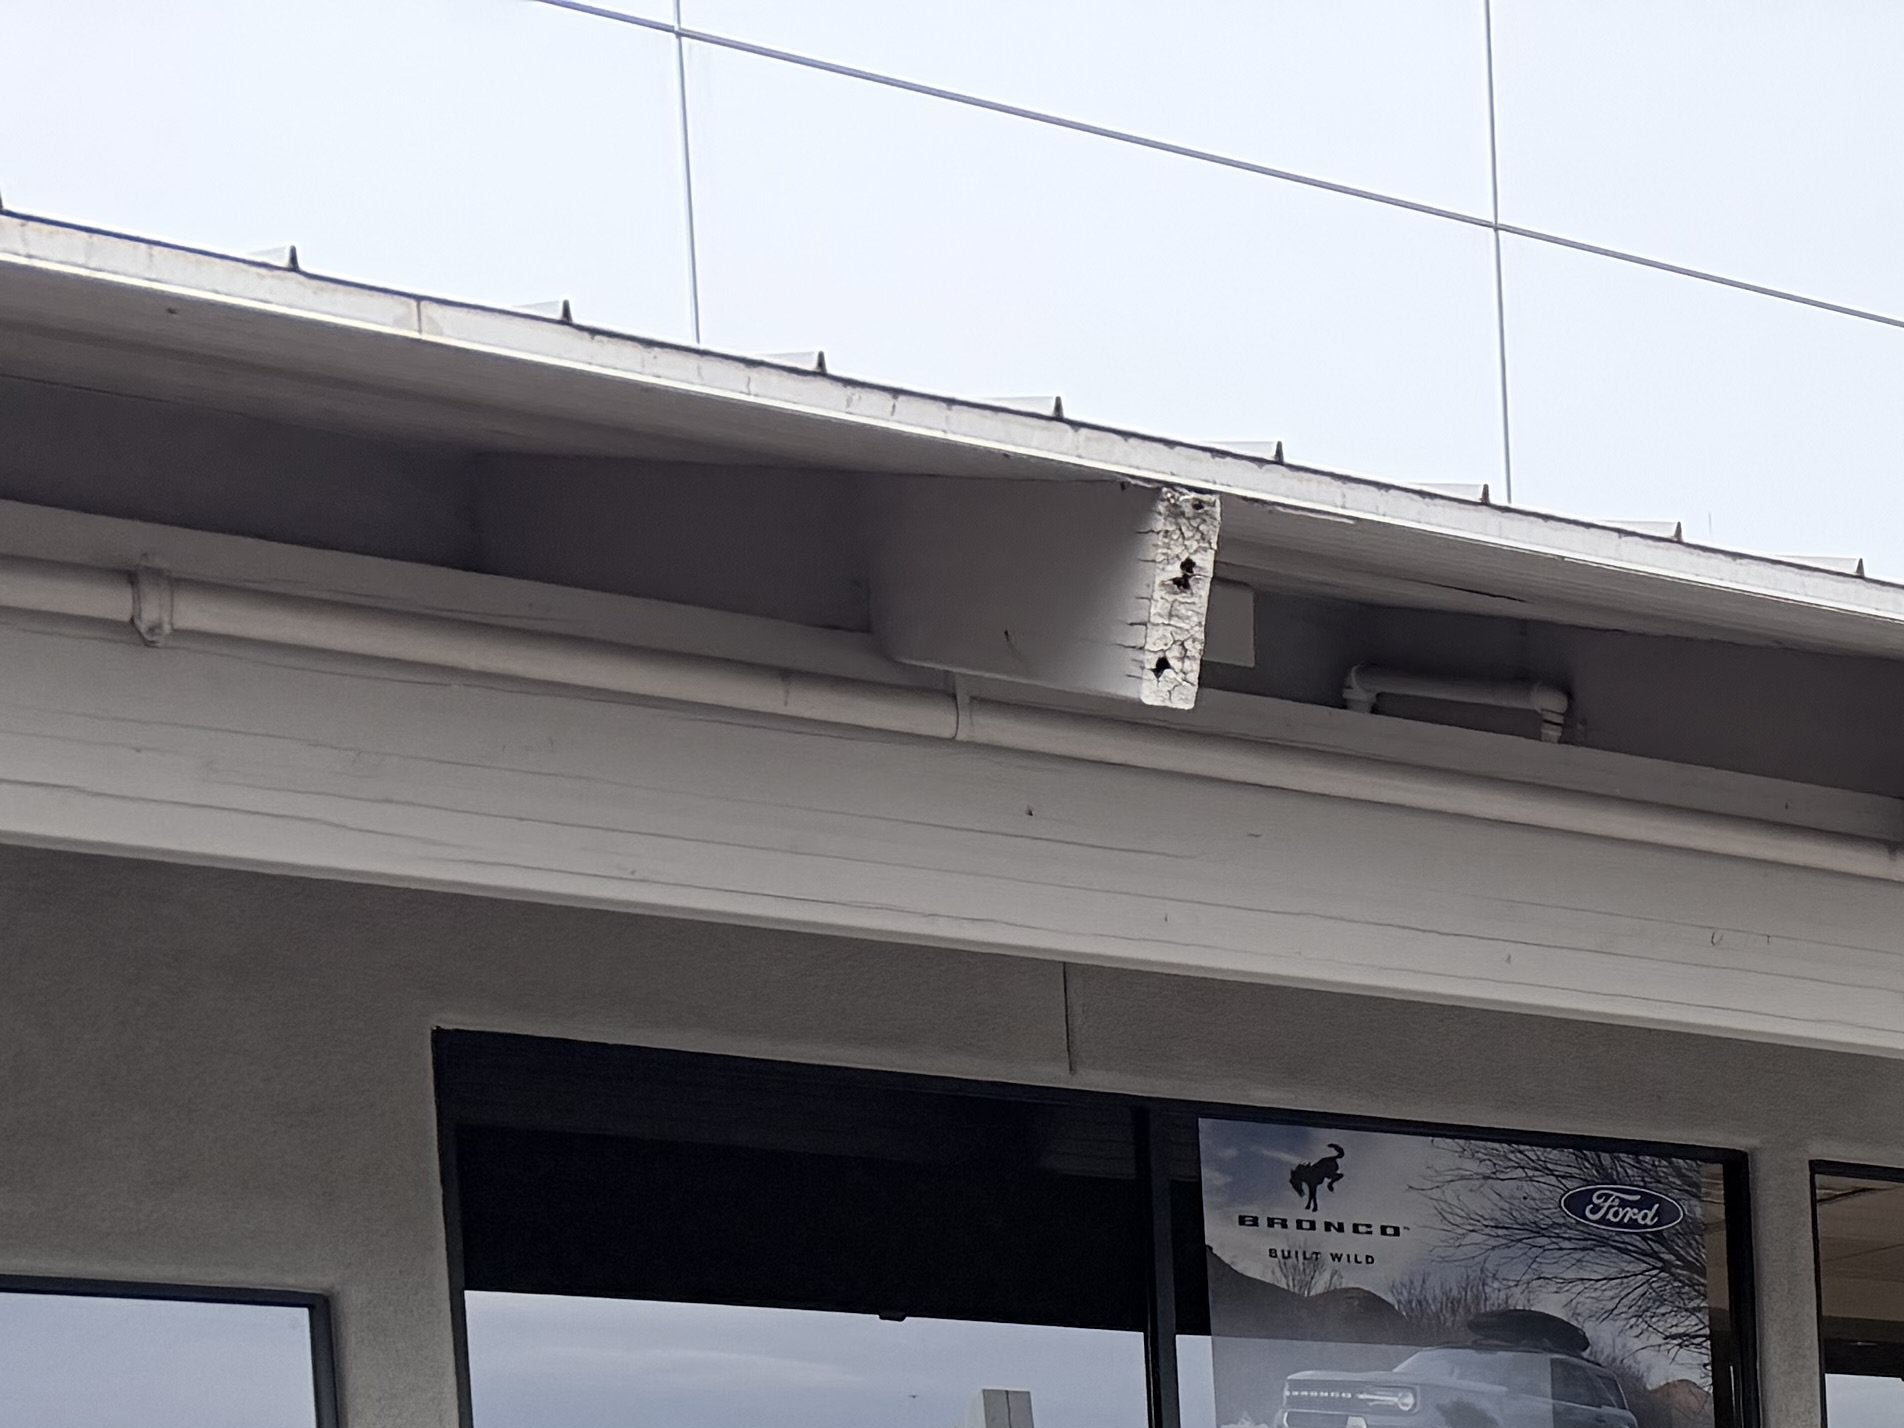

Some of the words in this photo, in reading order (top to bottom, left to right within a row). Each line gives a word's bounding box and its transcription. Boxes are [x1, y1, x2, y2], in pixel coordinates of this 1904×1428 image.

[1585, 1190, 1659, 1226] Ford
[1238, 1215, 1400, 1237] BRONCO
[1268, 1248, 1321, 1262] BUILT
[1330, 1252, 1375, 1265] WILD
